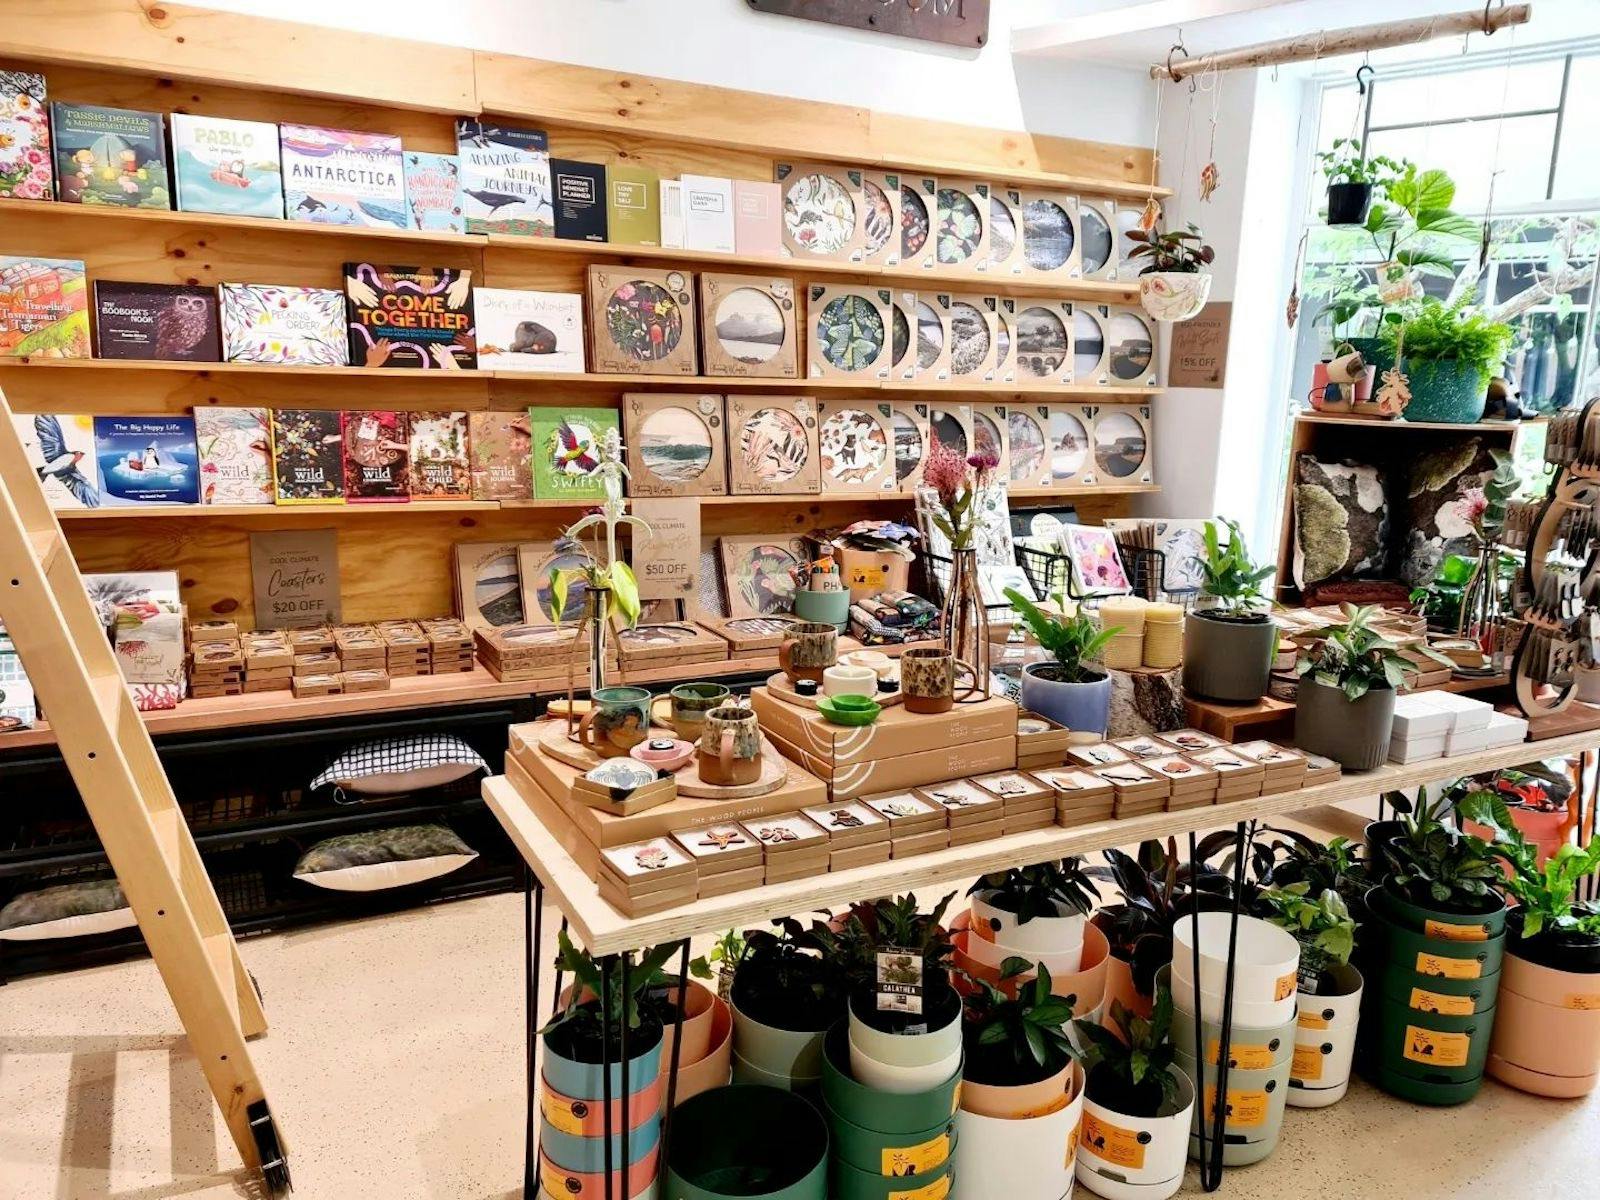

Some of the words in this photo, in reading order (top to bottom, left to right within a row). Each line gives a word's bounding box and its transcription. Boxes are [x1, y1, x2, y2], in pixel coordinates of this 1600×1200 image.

[194, 128, 254, 147] PABLO
[470, 152, 522, 166] AMAZING
[292, 163, 396, 187] ANTARCTICA
[504, 168, 546, 186] ANIMAL
[483, 178, 538, 197] JOURNEYS
[382, 293, 446, 314] COME
[130, 315, 154, 324] NOOK
[358, 307, 470, 330] TOGETHER
[1199, 357, 1217, 367] OFF
[130, 424, 142, 432] Big
[143, 424, 164, 432] Happy
[220, 465, 249, 478] wild
[294, 468, 325, 480] wild
[363, 467, 391, 478] wild
[425, 465, 452, 476] wild
[491, 465, 515, 476] wild
[426, 476, 453, 484] CHILD
[645, 563, 664, 575] $50
[667, 563, 688, 575] OFF
[268, 568, 327, 598] Coasters
[273, 601, 296, 614] $20
[299, 600, 325, 611] OFF
[882, 984, 916, 994] CALATHEA
